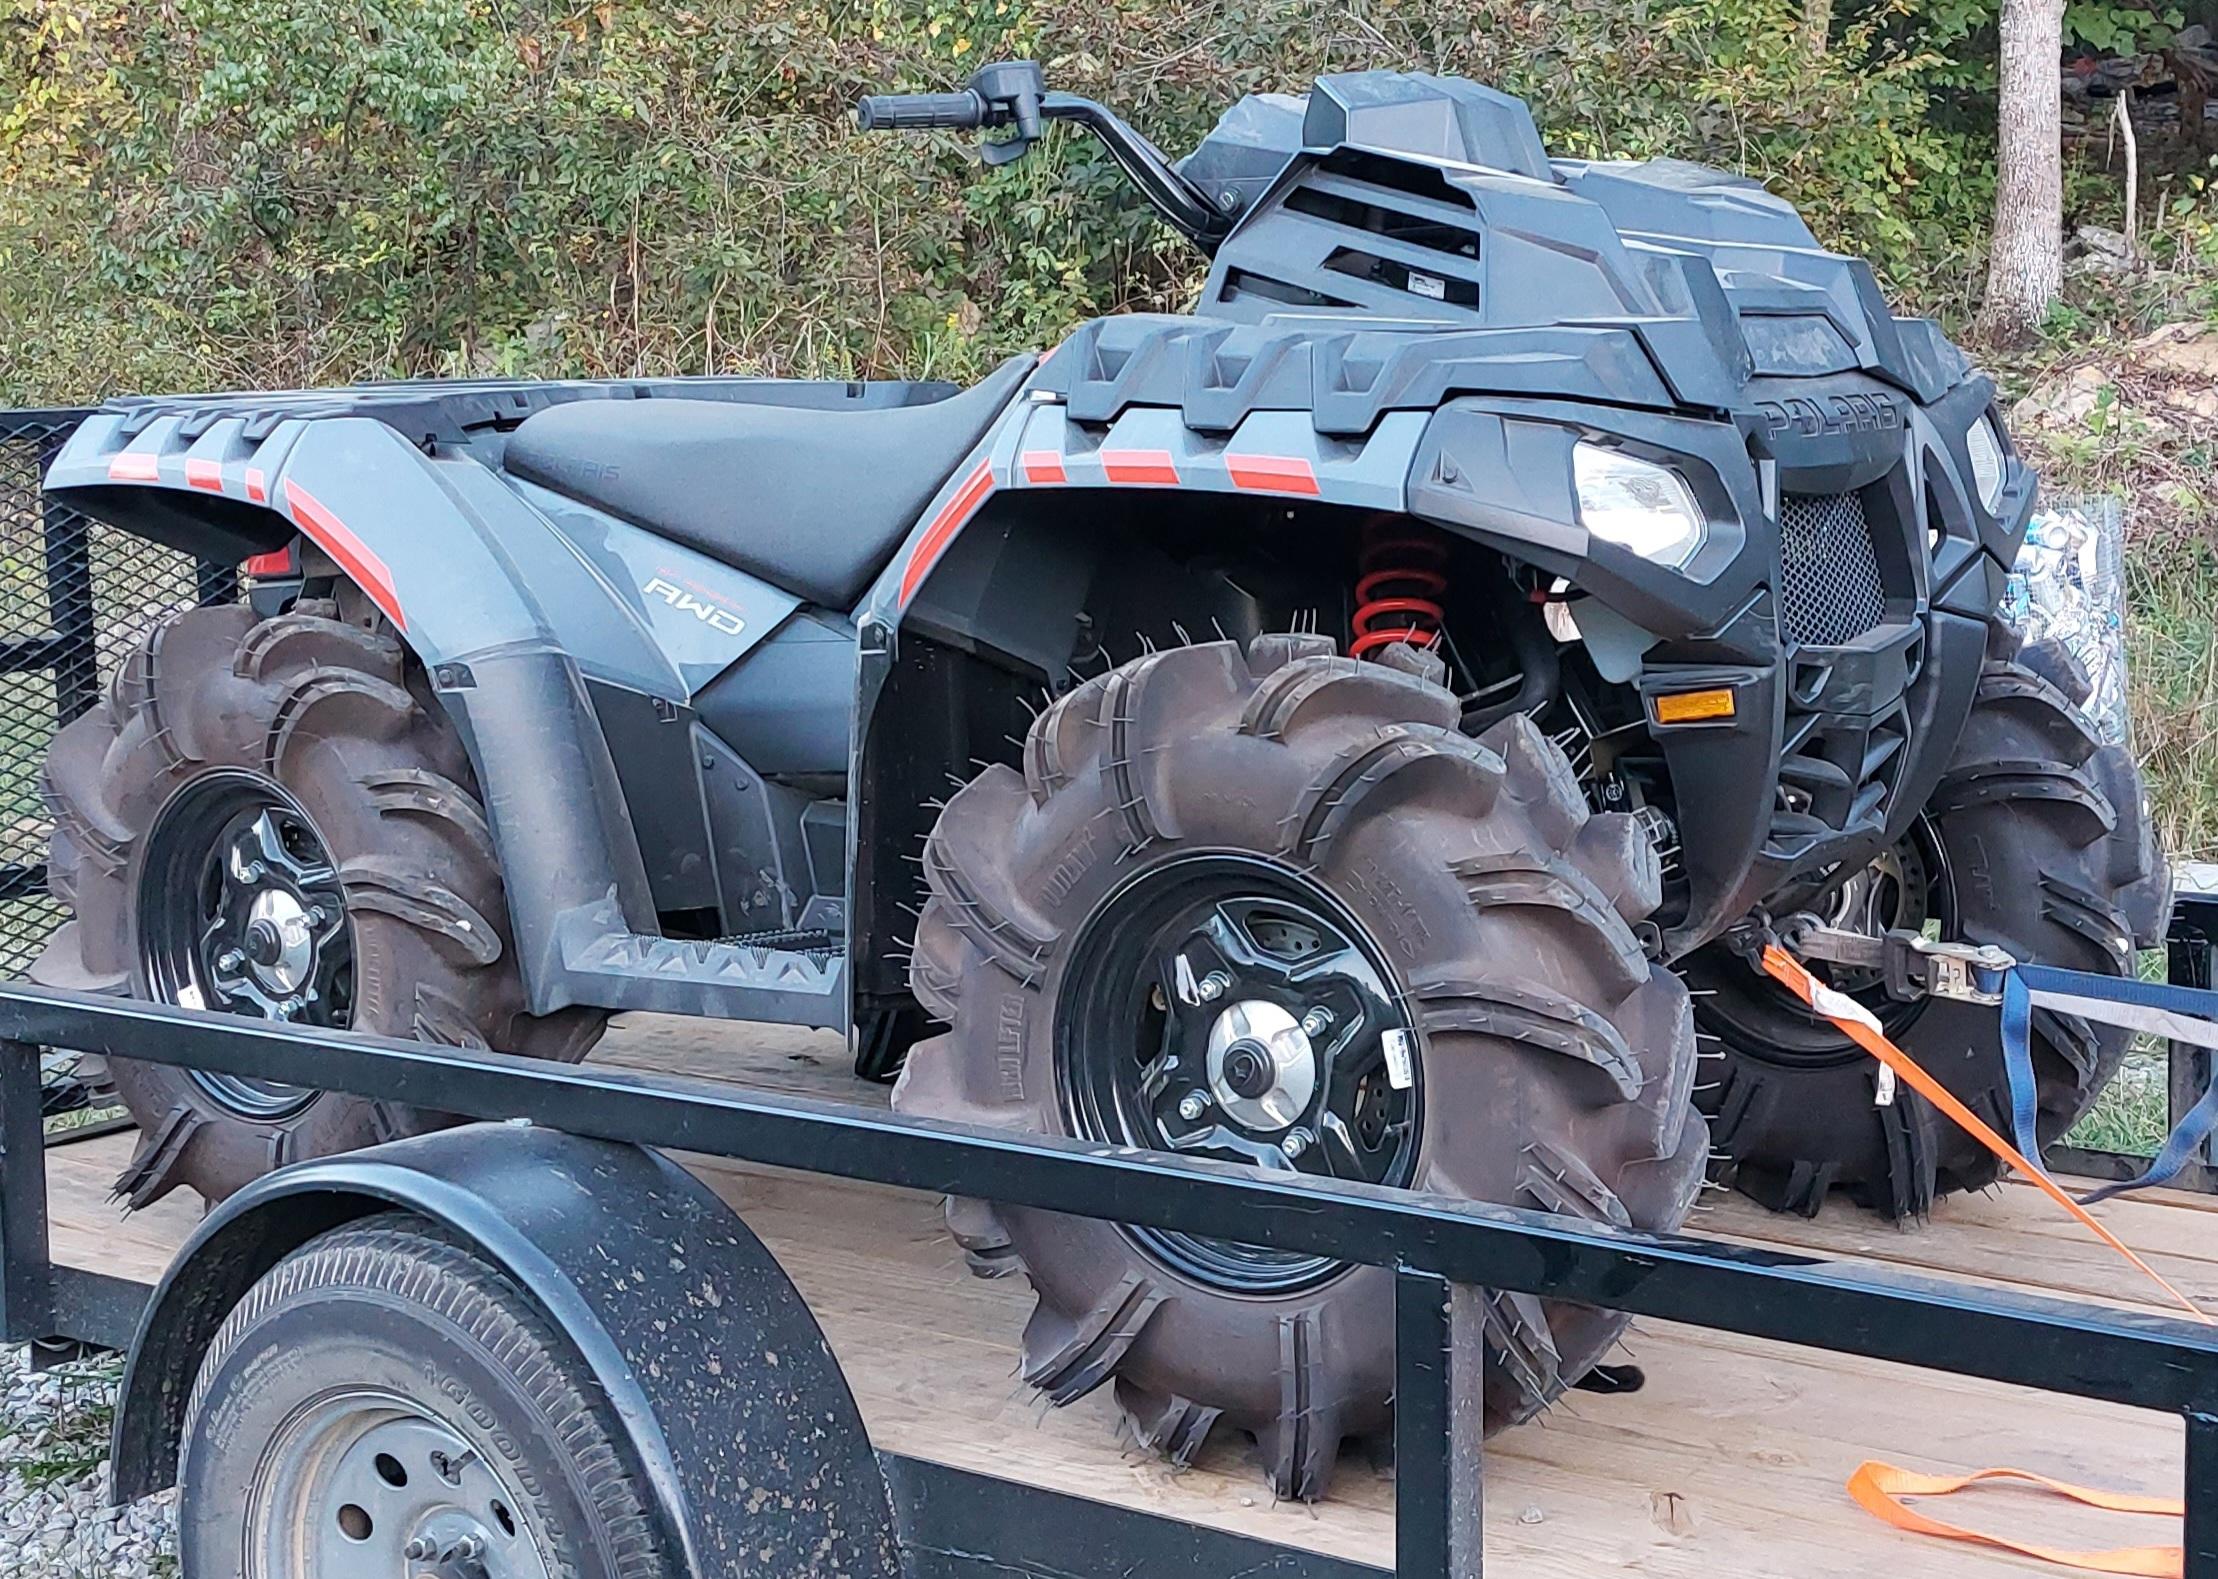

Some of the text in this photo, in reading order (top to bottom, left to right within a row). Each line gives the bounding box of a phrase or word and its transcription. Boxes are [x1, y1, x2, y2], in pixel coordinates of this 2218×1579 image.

[1754, 393, 1898, 441] POLARIS
[526, 451, 622, 482] POLRIS
[642, 576, 747, 636] AWD
